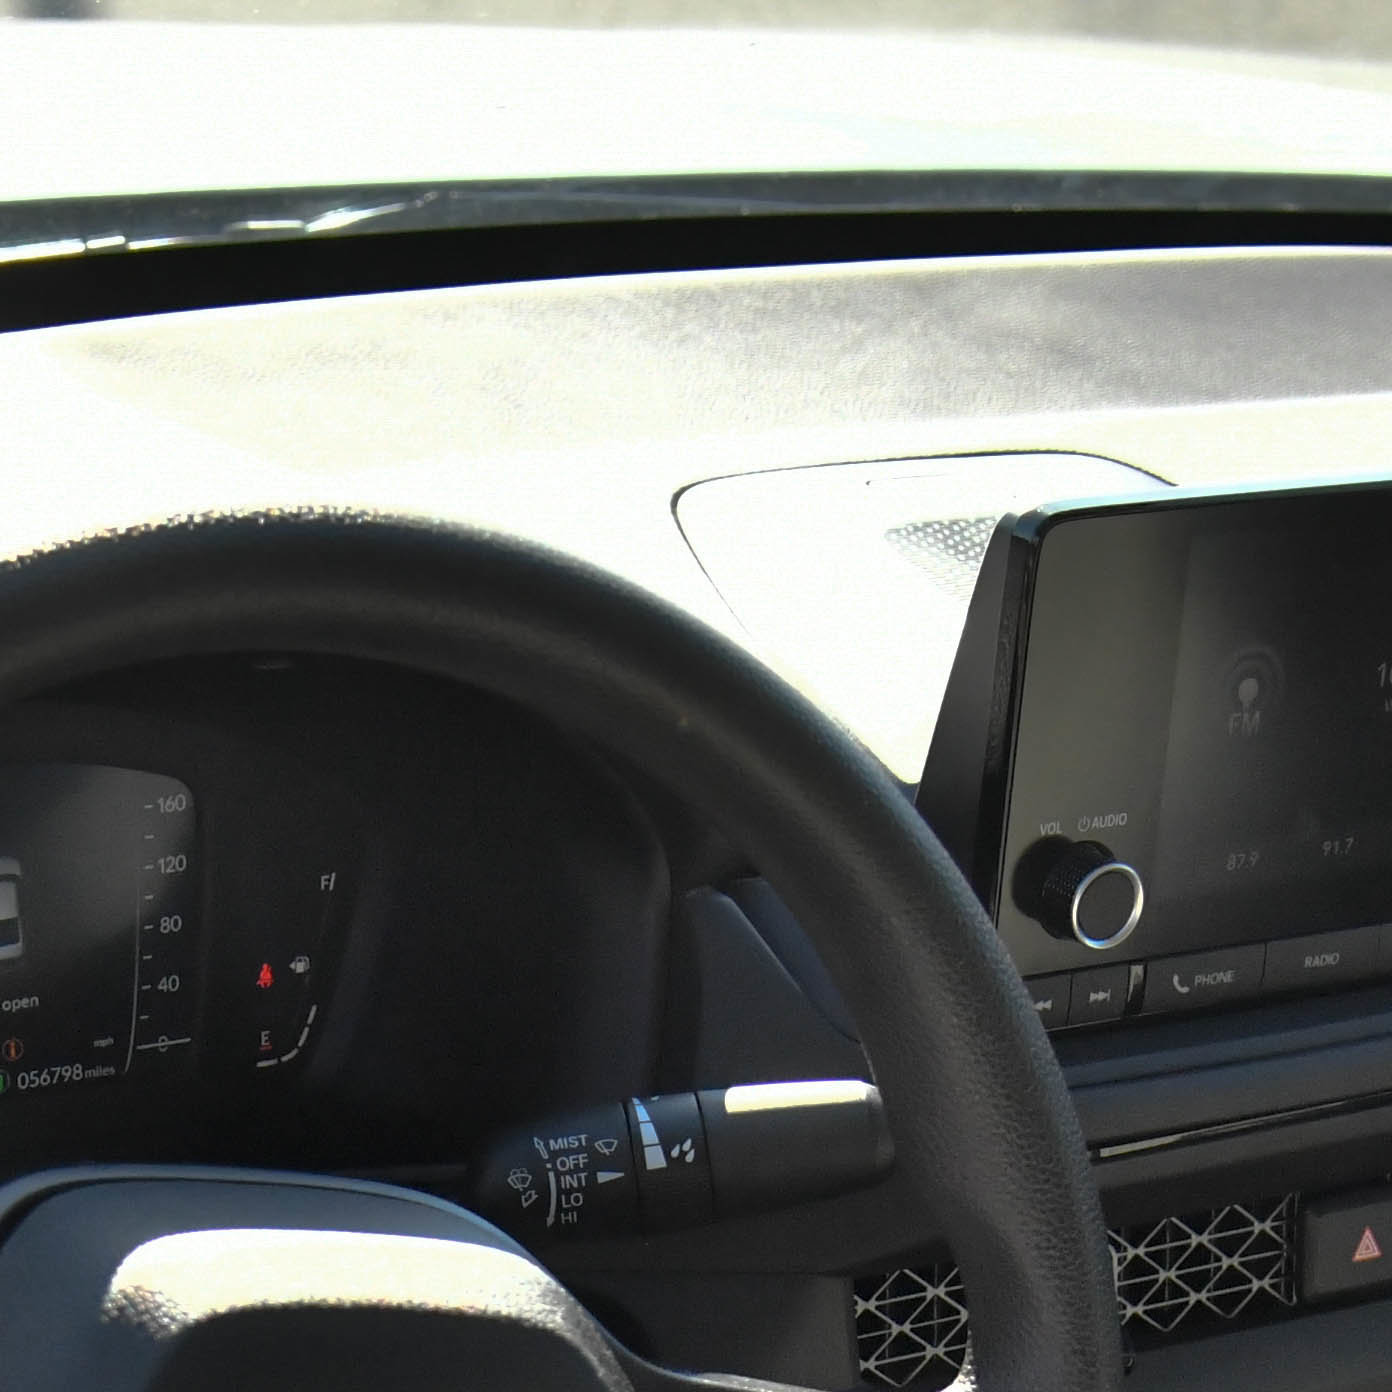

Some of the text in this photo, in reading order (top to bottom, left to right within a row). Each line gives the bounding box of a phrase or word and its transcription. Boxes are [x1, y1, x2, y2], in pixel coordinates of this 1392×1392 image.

[1228, 711, 1262, 736] FM
[157, 793, 187, 813] 160
[1039, 820, 1063, 837] VOL
[1091, 812, 1128, 830] AUDIO
[1321, 837, 1355, 856] 91.7
[157, 854, 187, 874] 120
[1225, 852, 1259, 872] 87.9
[159, 914, 183, 934] 80
[1304, 952, 1340, 969] RADIO
[157, 974, 180, 993] 40
[1194, 969, 1236, 988] PHONE
[1, 994, 40, 1014] open
[92, 1035, 115, 1050] mph
[16, 1063, 116, 1089] 056798 miles
[549, 1134, 588, 1151] MIST
[556, 1153, 588, 1171] OFF
[560, 1172, 589, 1190] INT
[561, 1192, 584, 1208] LO
[560, 1211, 578, 1225] HI
